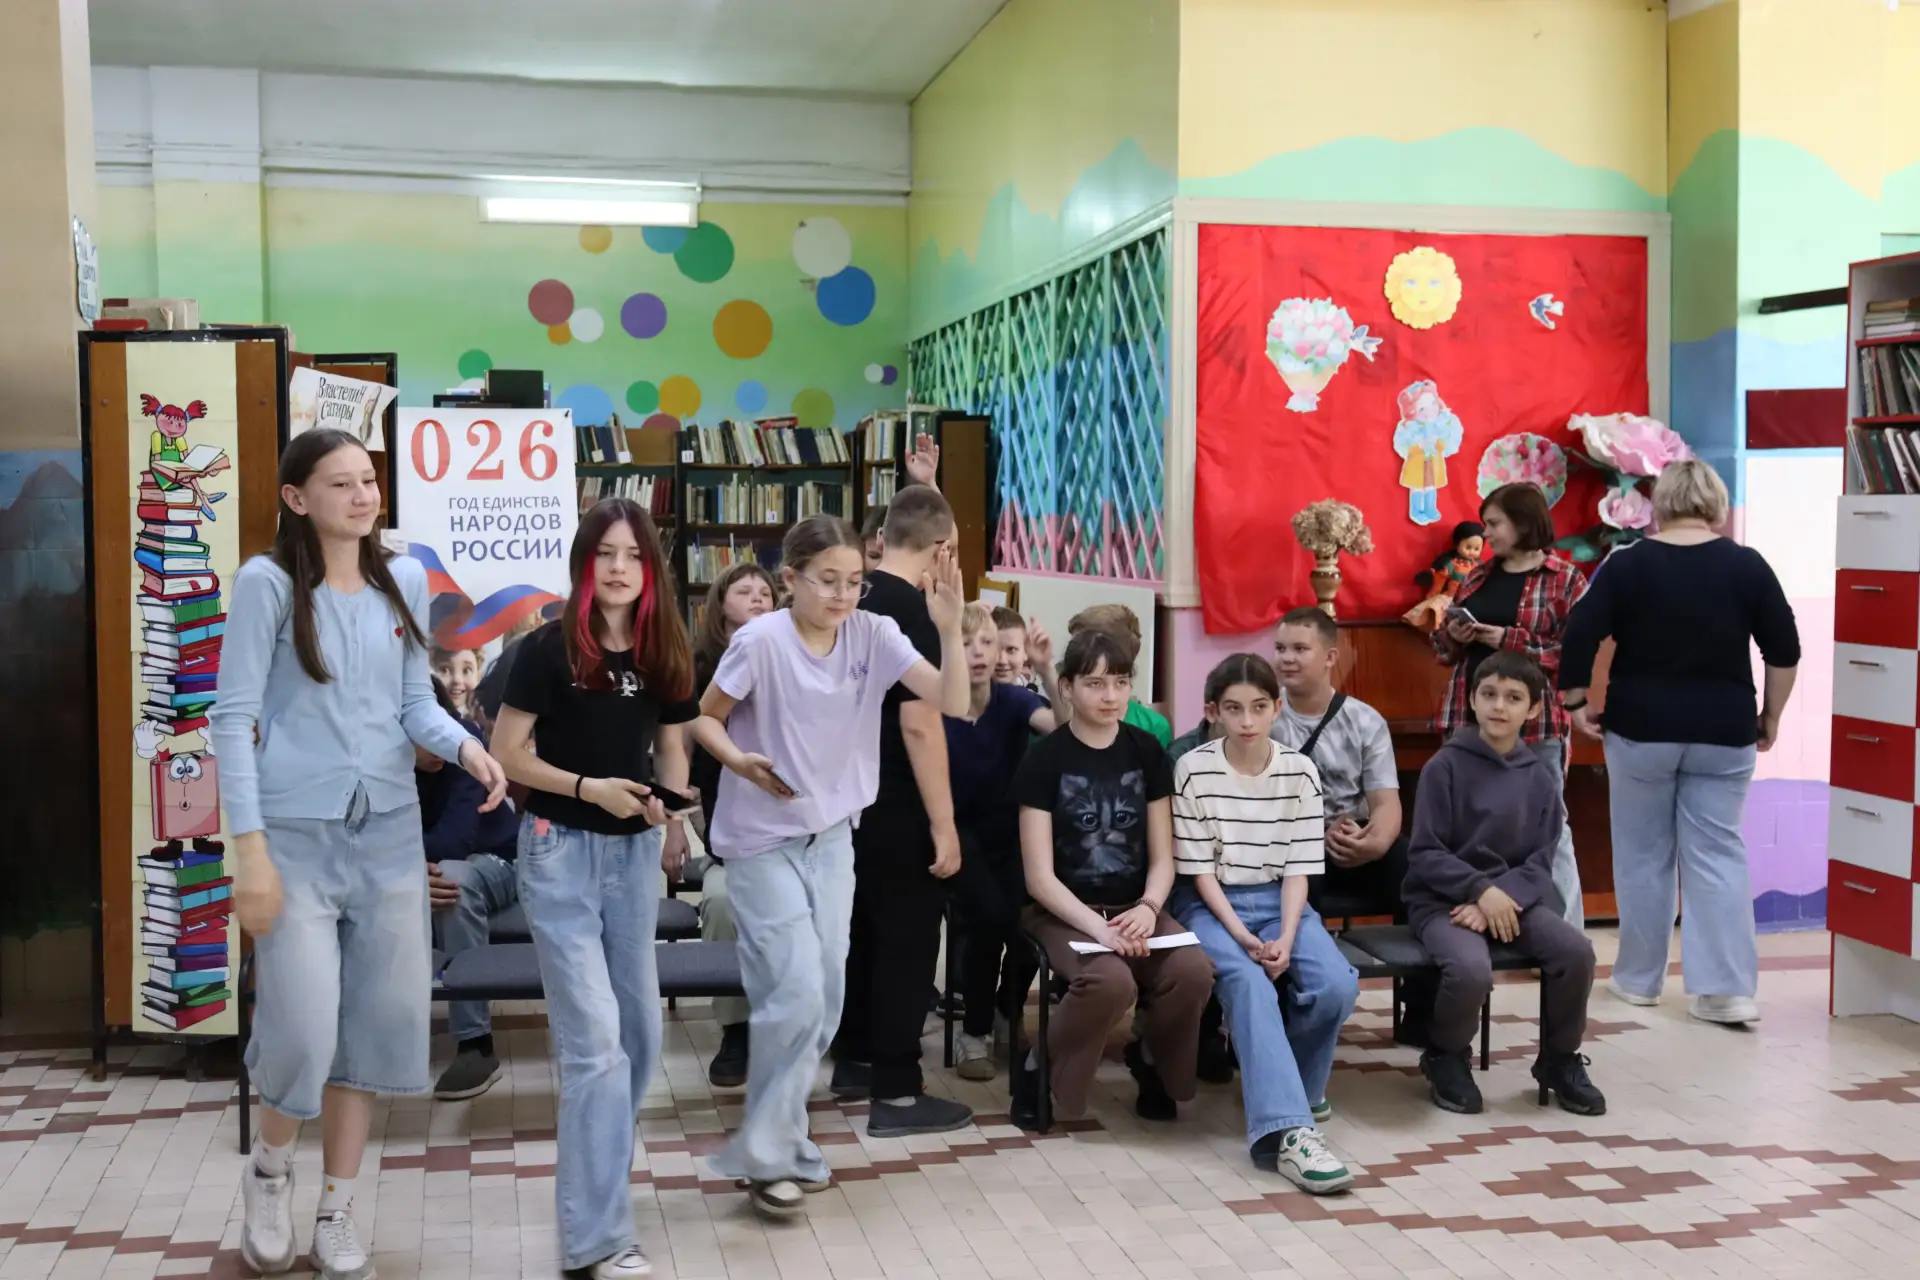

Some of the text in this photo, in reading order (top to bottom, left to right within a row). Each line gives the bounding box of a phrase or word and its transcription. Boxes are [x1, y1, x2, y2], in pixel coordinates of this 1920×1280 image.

[411, 419, 558, 483] 026
[449, 496, 561, 512] ГОД ЕДИНСТВА
[450, 514, 561, 535] НАРОДОВ
[452, 538, 562, 561] РОССИИ
